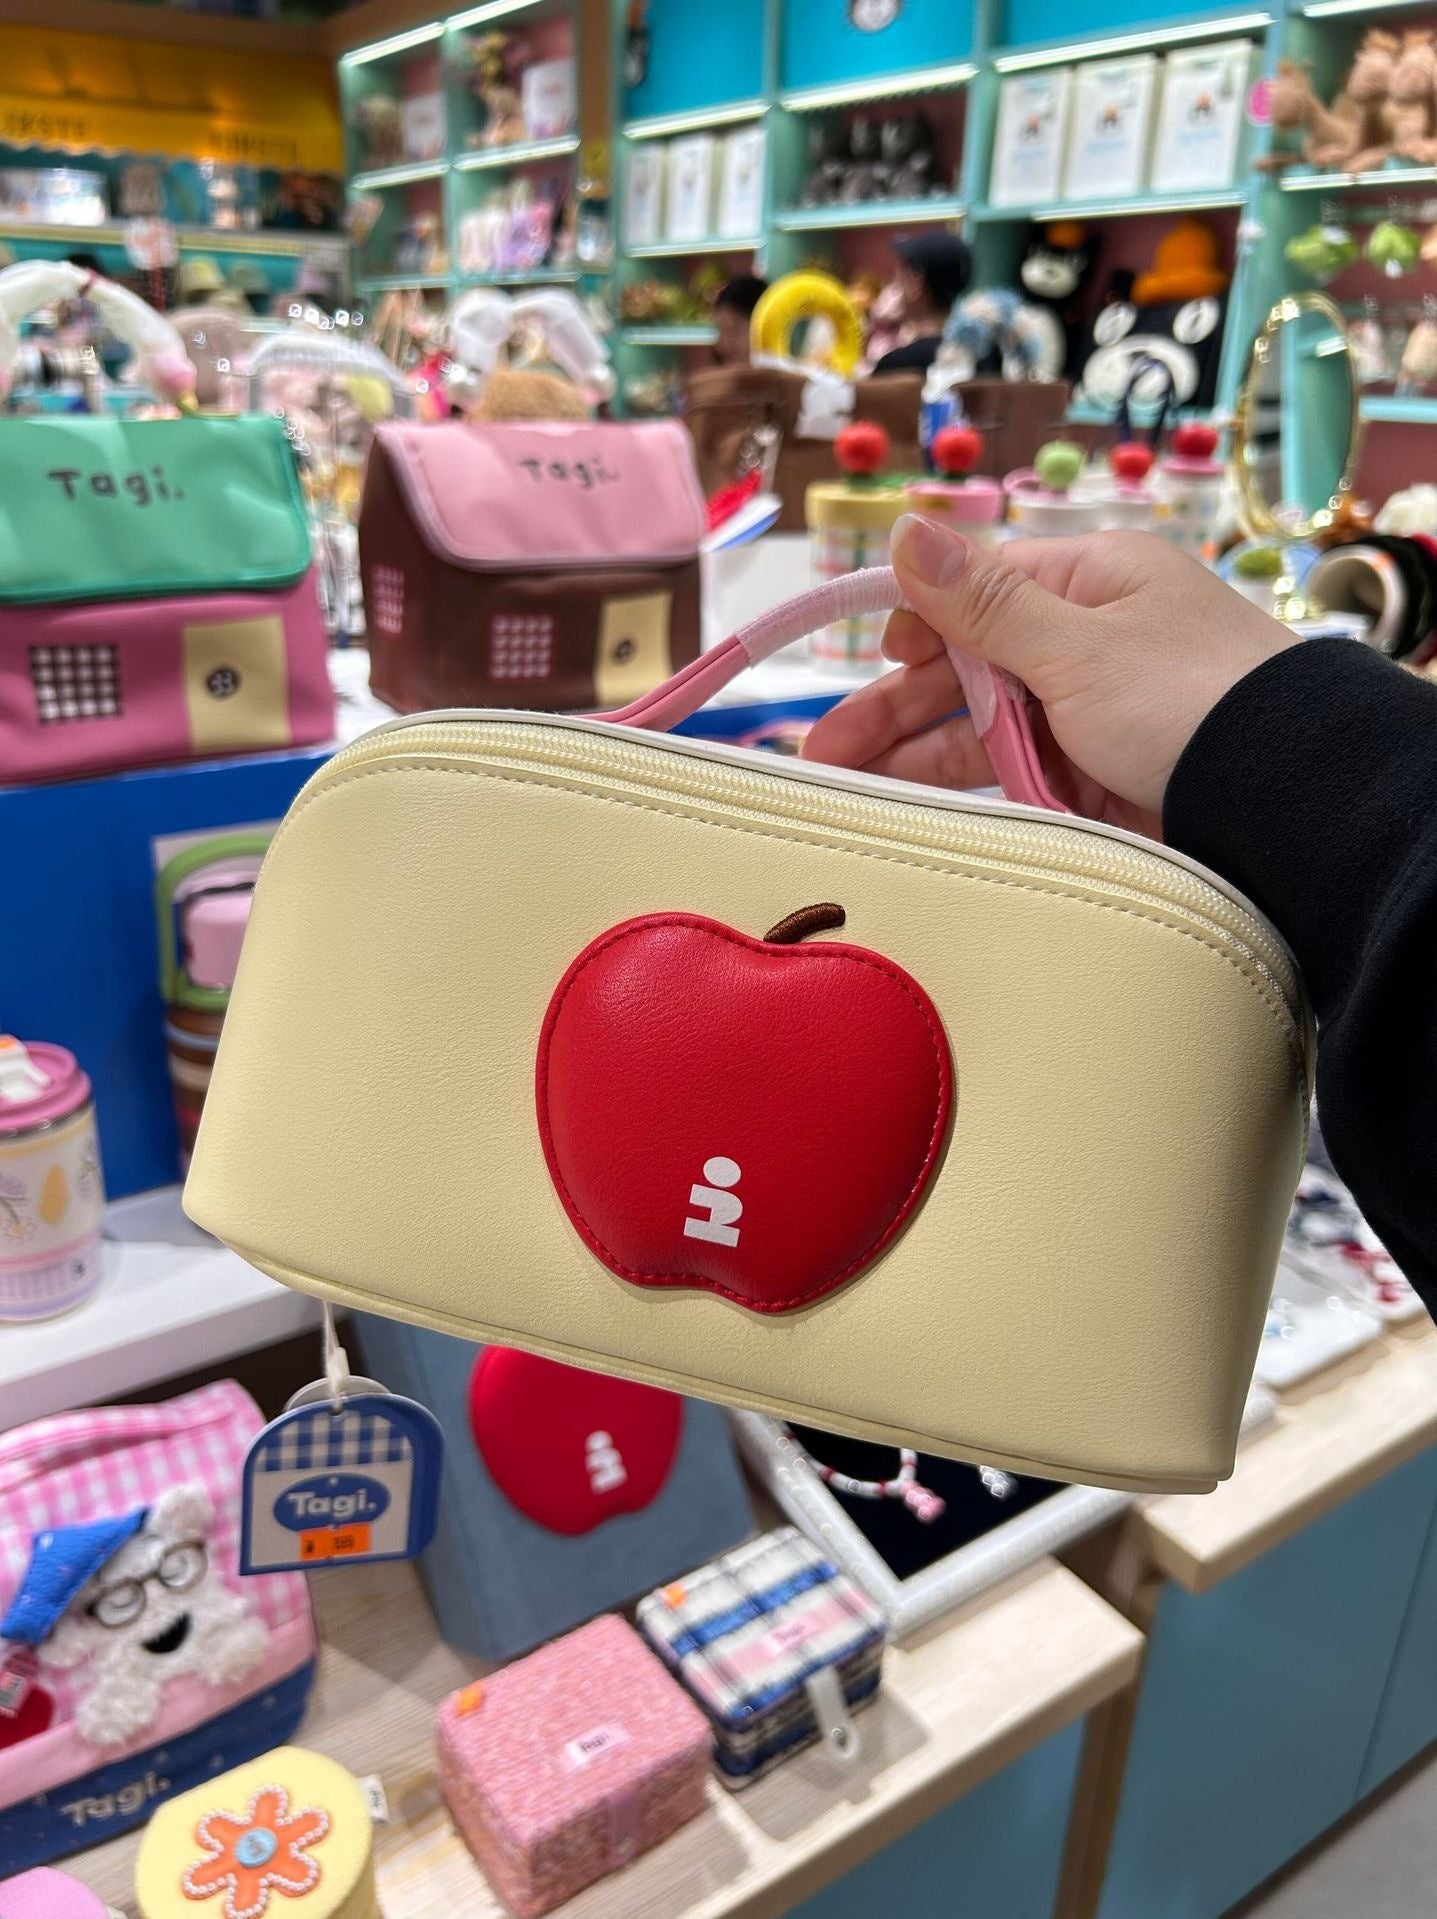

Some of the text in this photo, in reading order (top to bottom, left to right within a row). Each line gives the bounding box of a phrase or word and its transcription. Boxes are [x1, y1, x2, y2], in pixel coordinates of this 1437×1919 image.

[47, 465, 185, 508] Tagi.
[287, 1488, 377, 1519] Tagi.
[60, 1770, 171, 1826] Tagi.
